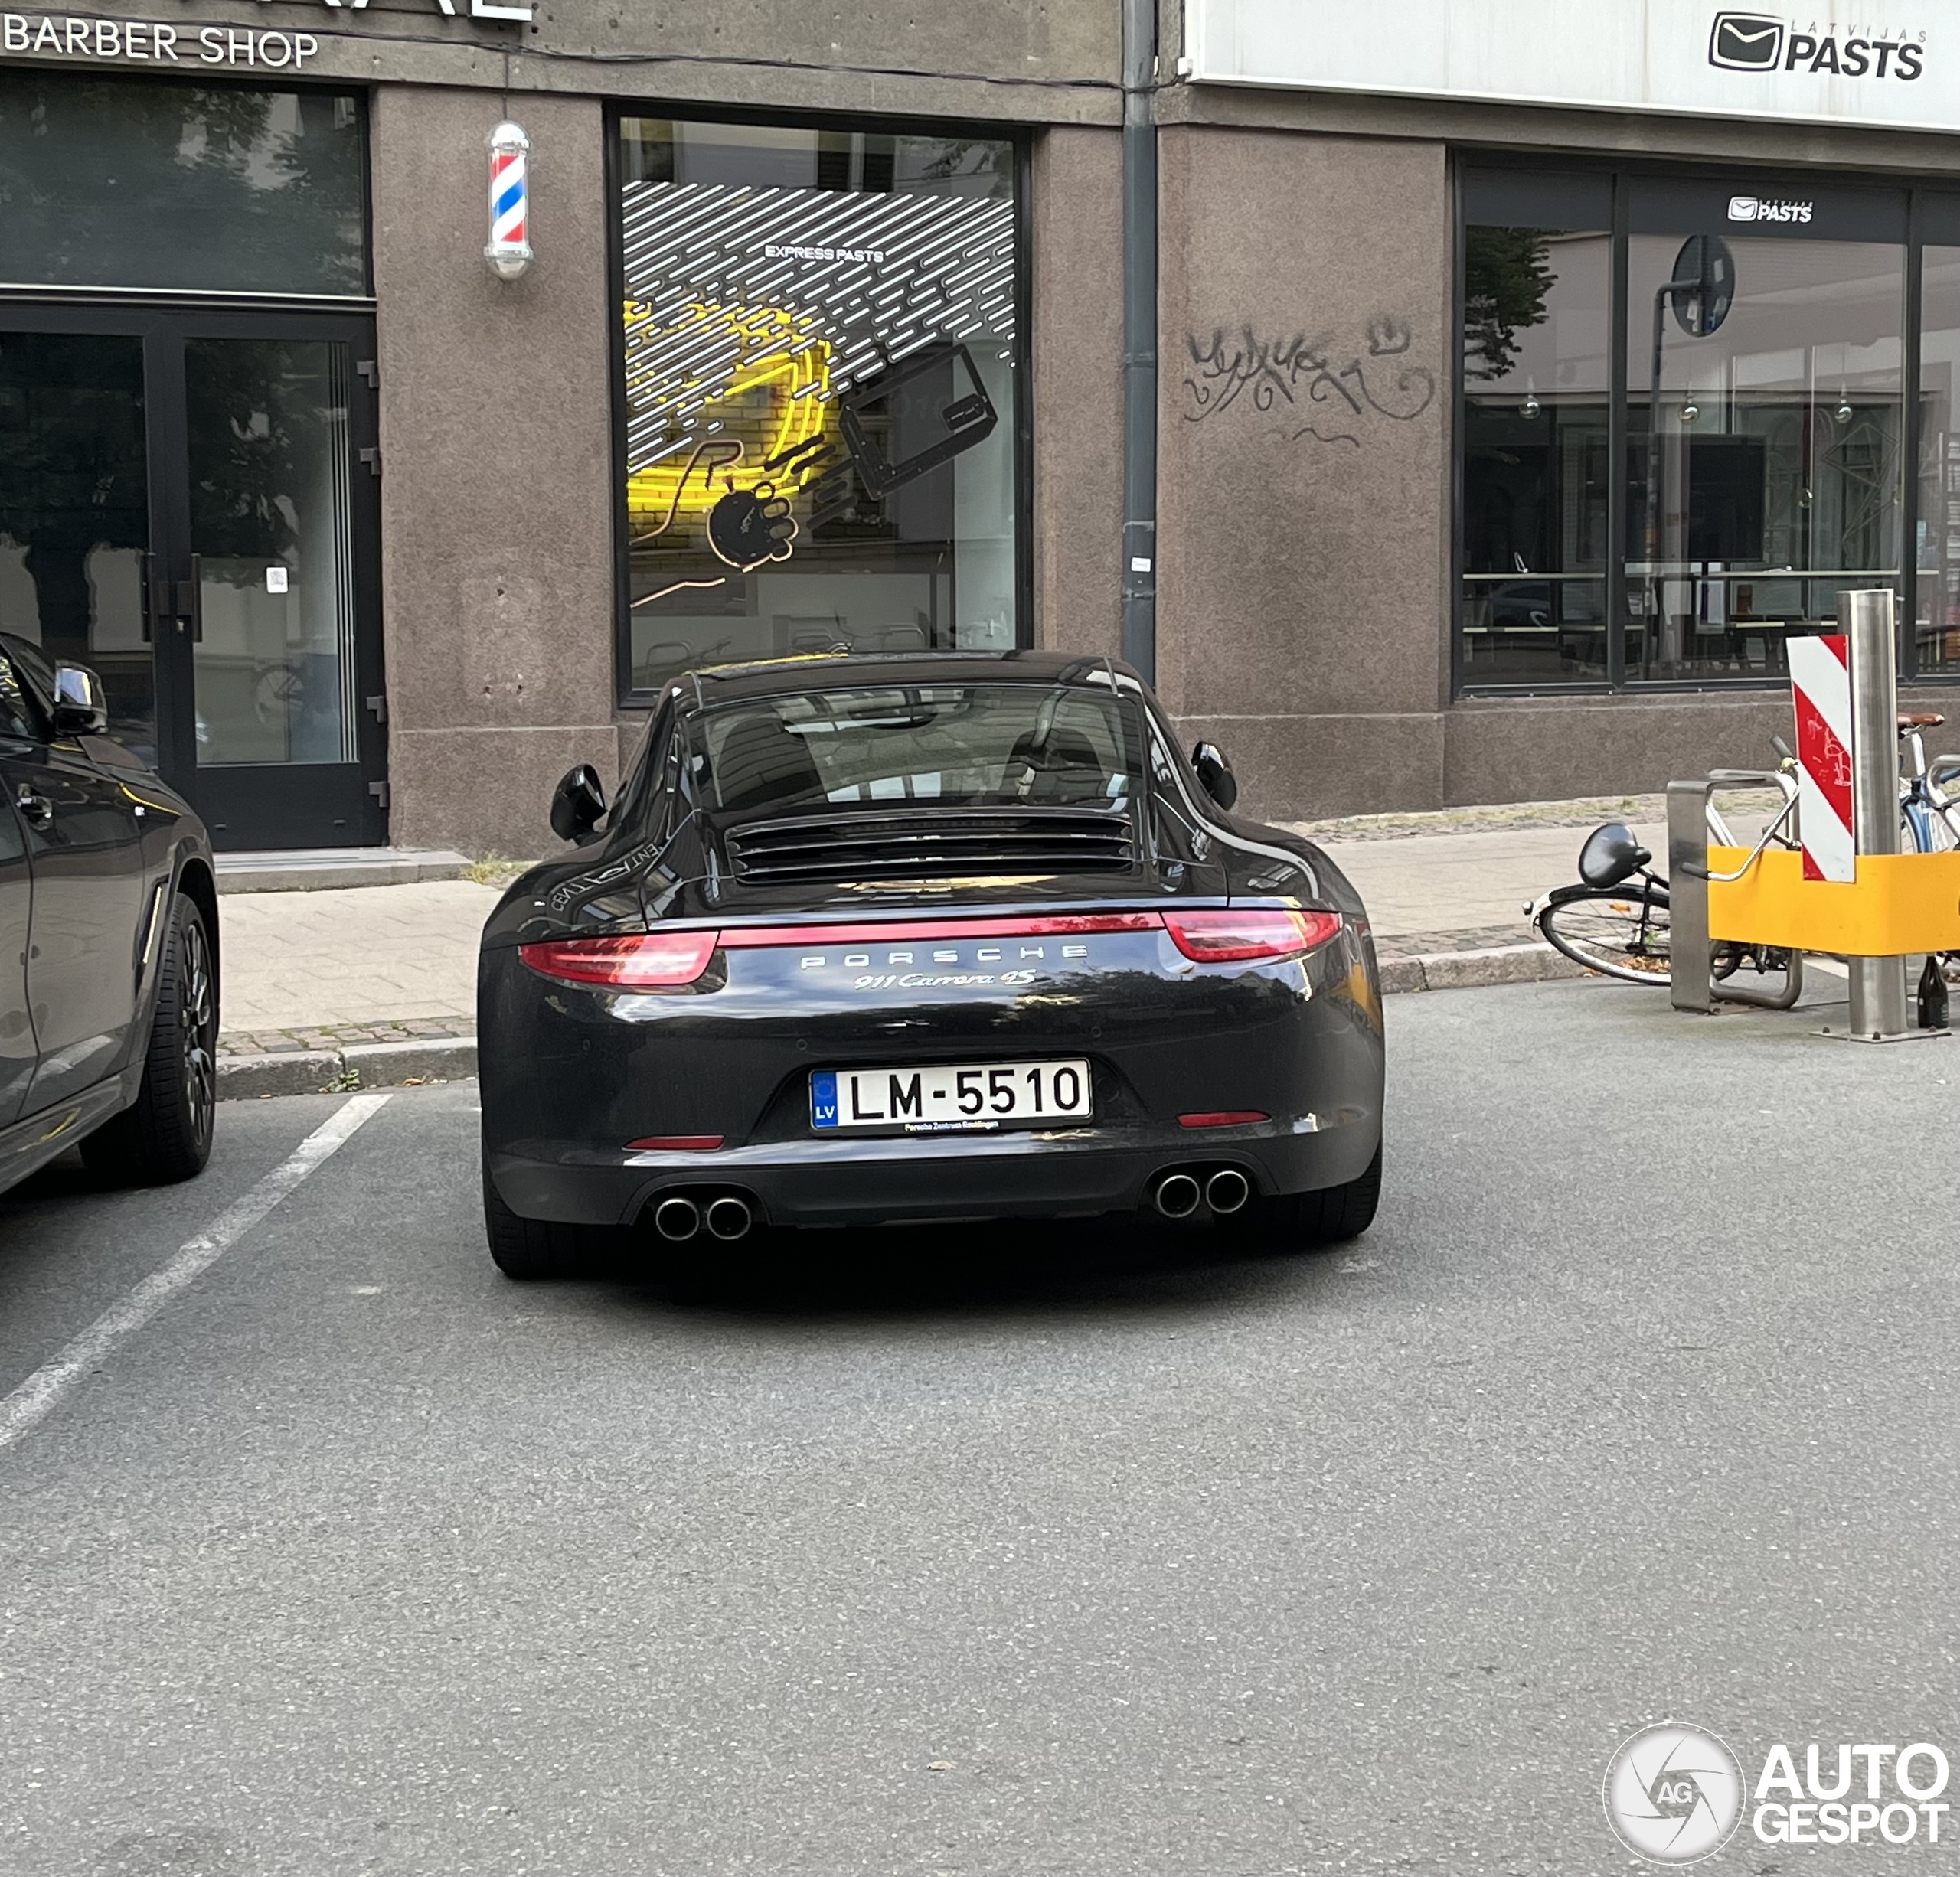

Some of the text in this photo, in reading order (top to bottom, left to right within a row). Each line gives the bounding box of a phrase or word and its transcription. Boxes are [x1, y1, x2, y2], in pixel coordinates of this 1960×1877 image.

[3, 13, 318, 69] BARBER SHOP
[1790, 18, 1927, 43] LATVIJAS
[1785, 34, 1924, 81] PASTS
[1757, 204, 1812, 223] PASTS
[765, 245, 884, 263] EXPRESS PASTS
[801, 945, 1089, 970] PORSCHE
[854, 974, 897, 990] 911
[898, 973, 995, 987] Carrera
[851, 1066, 1080, 1121] LM-5510
[815, 1105, 835, 1121] LV
